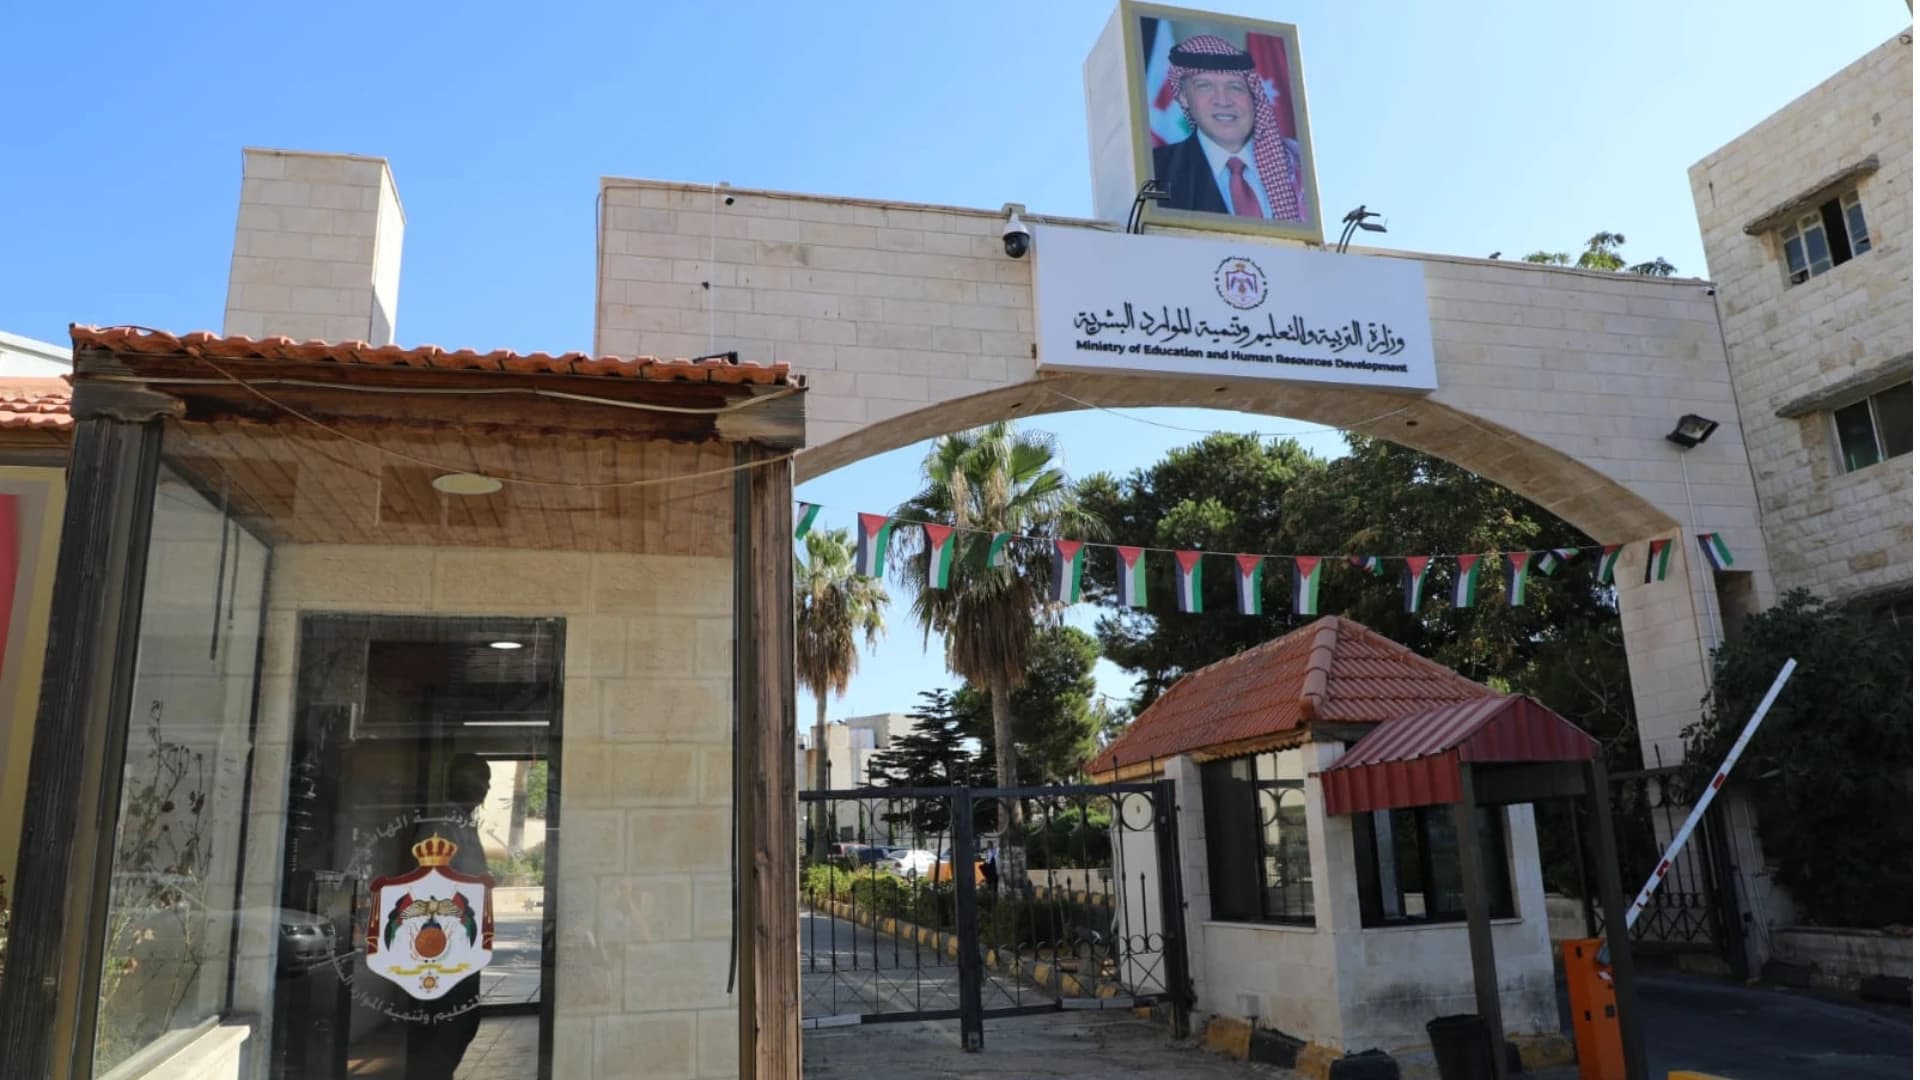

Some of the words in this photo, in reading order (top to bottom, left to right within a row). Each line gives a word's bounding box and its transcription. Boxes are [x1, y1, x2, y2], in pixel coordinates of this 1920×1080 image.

[1073, 300, 1135, 336] البشرية
[1195, 315, 1250, 345] وتنمية
[1239, 312, 1317, 349] والتعليم
[1314, 319, 1363, 353] التربية
[1367, 322, 1405, 356] وزارة
[1076, 339, 1126, 356] Ministry
[1128, 343, 1141, 354] of
[1144, 344, 1204, 358] Education
[1207, 349, 1229, 360] and
[1231, 350, 1273, 363] Human
[1276, 354, 1334, 367] Resources
[1335, 357, 1408, 373] Development
